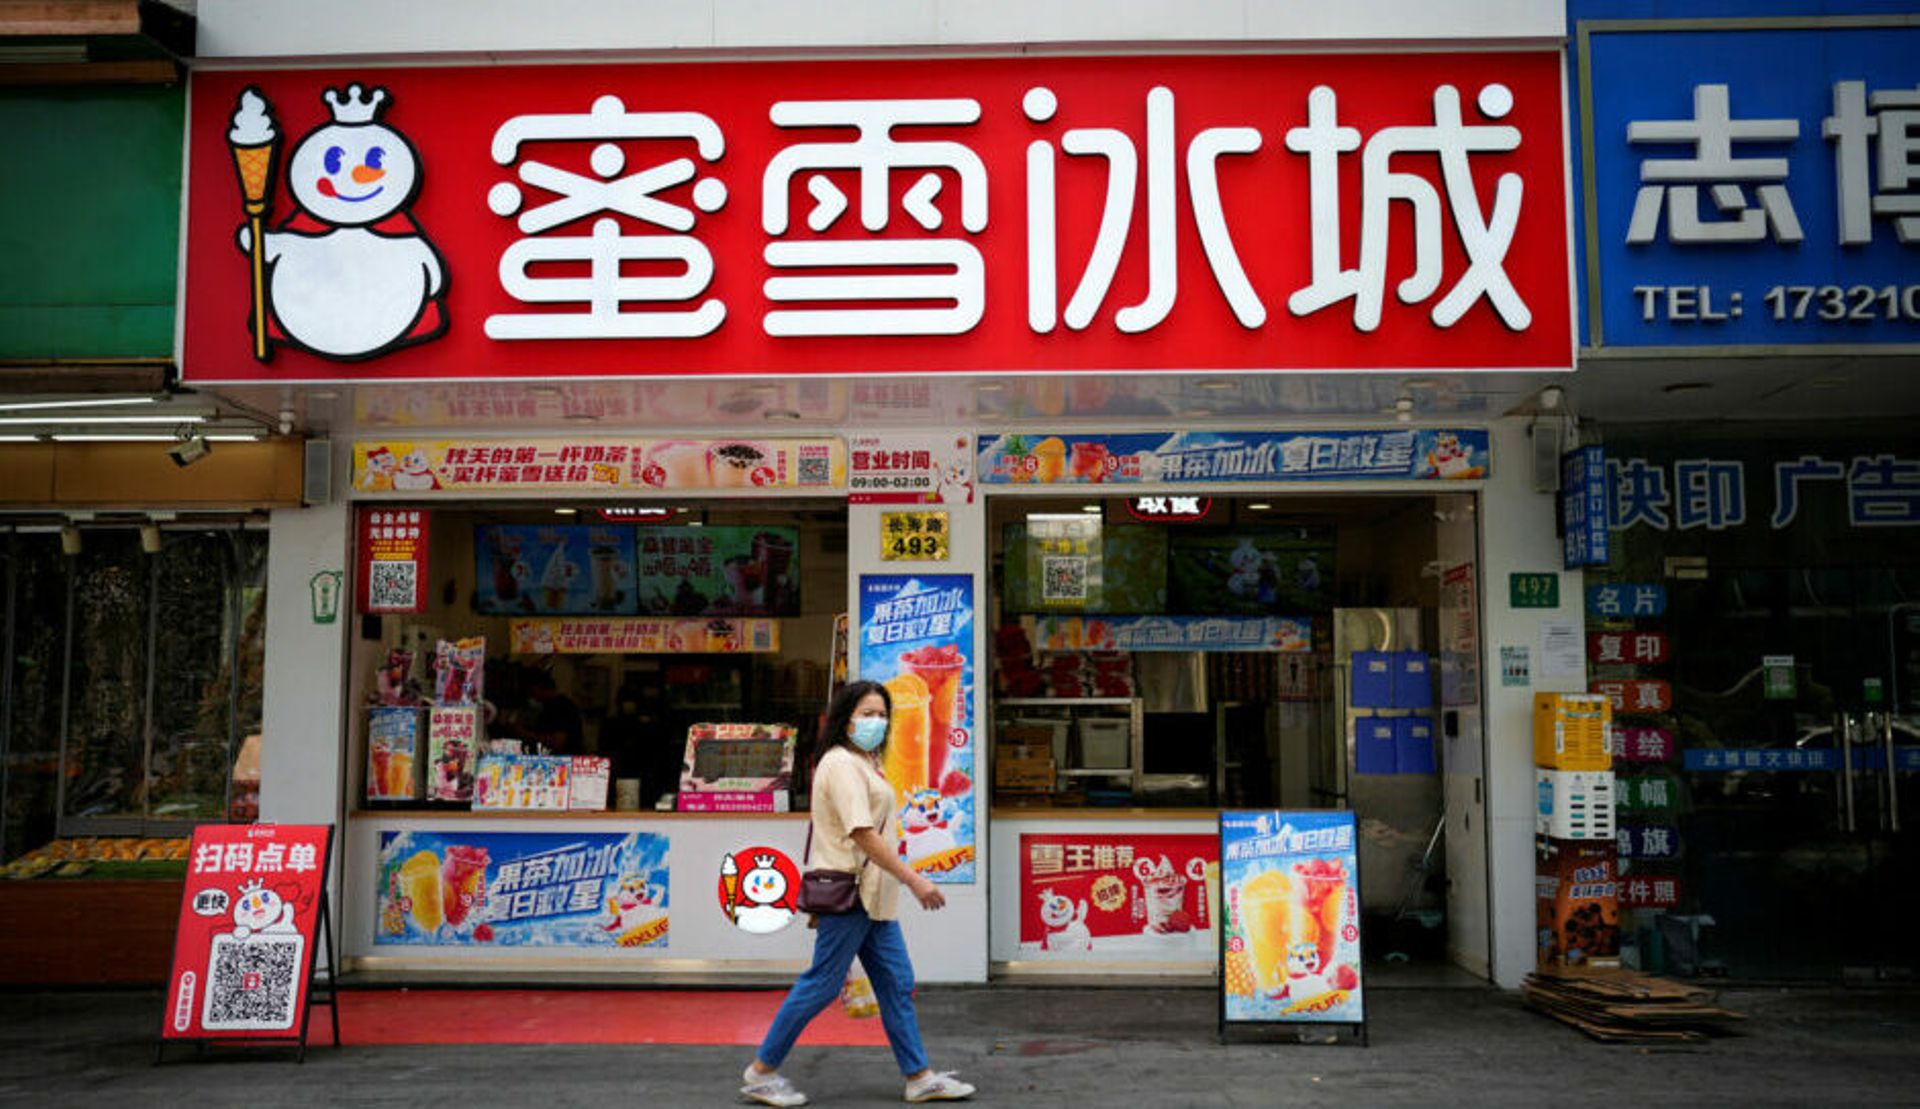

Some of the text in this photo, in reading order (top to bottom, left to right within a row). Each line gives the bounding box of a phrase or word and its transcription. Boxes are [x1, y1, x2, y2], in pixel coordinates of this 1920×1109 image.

[484, 82, 1532, 340] 蜜雪冰城
[1633, 284, 1743, 320] TEL:
[852, 450, 930, 470] 营业时间
[1605, 457, 1746, 531] 快印
[1771, 454, 1920, 530] 广告
[893, 536, 937, 555] 493
[1518, 576, 1551, 596] 497
[1597, 587, 1658, 614] 名片
[1598, 635, 1661, 662] 复印
[1600, 682, 1662, 710] 写真
[194, 842, 318, 874] 扫码点单
[498, 843, 624, 893] 果茶加冰
[1029, 843, 1135, 876] 雪王推荐
[196, 893, 227, 911] 更快
